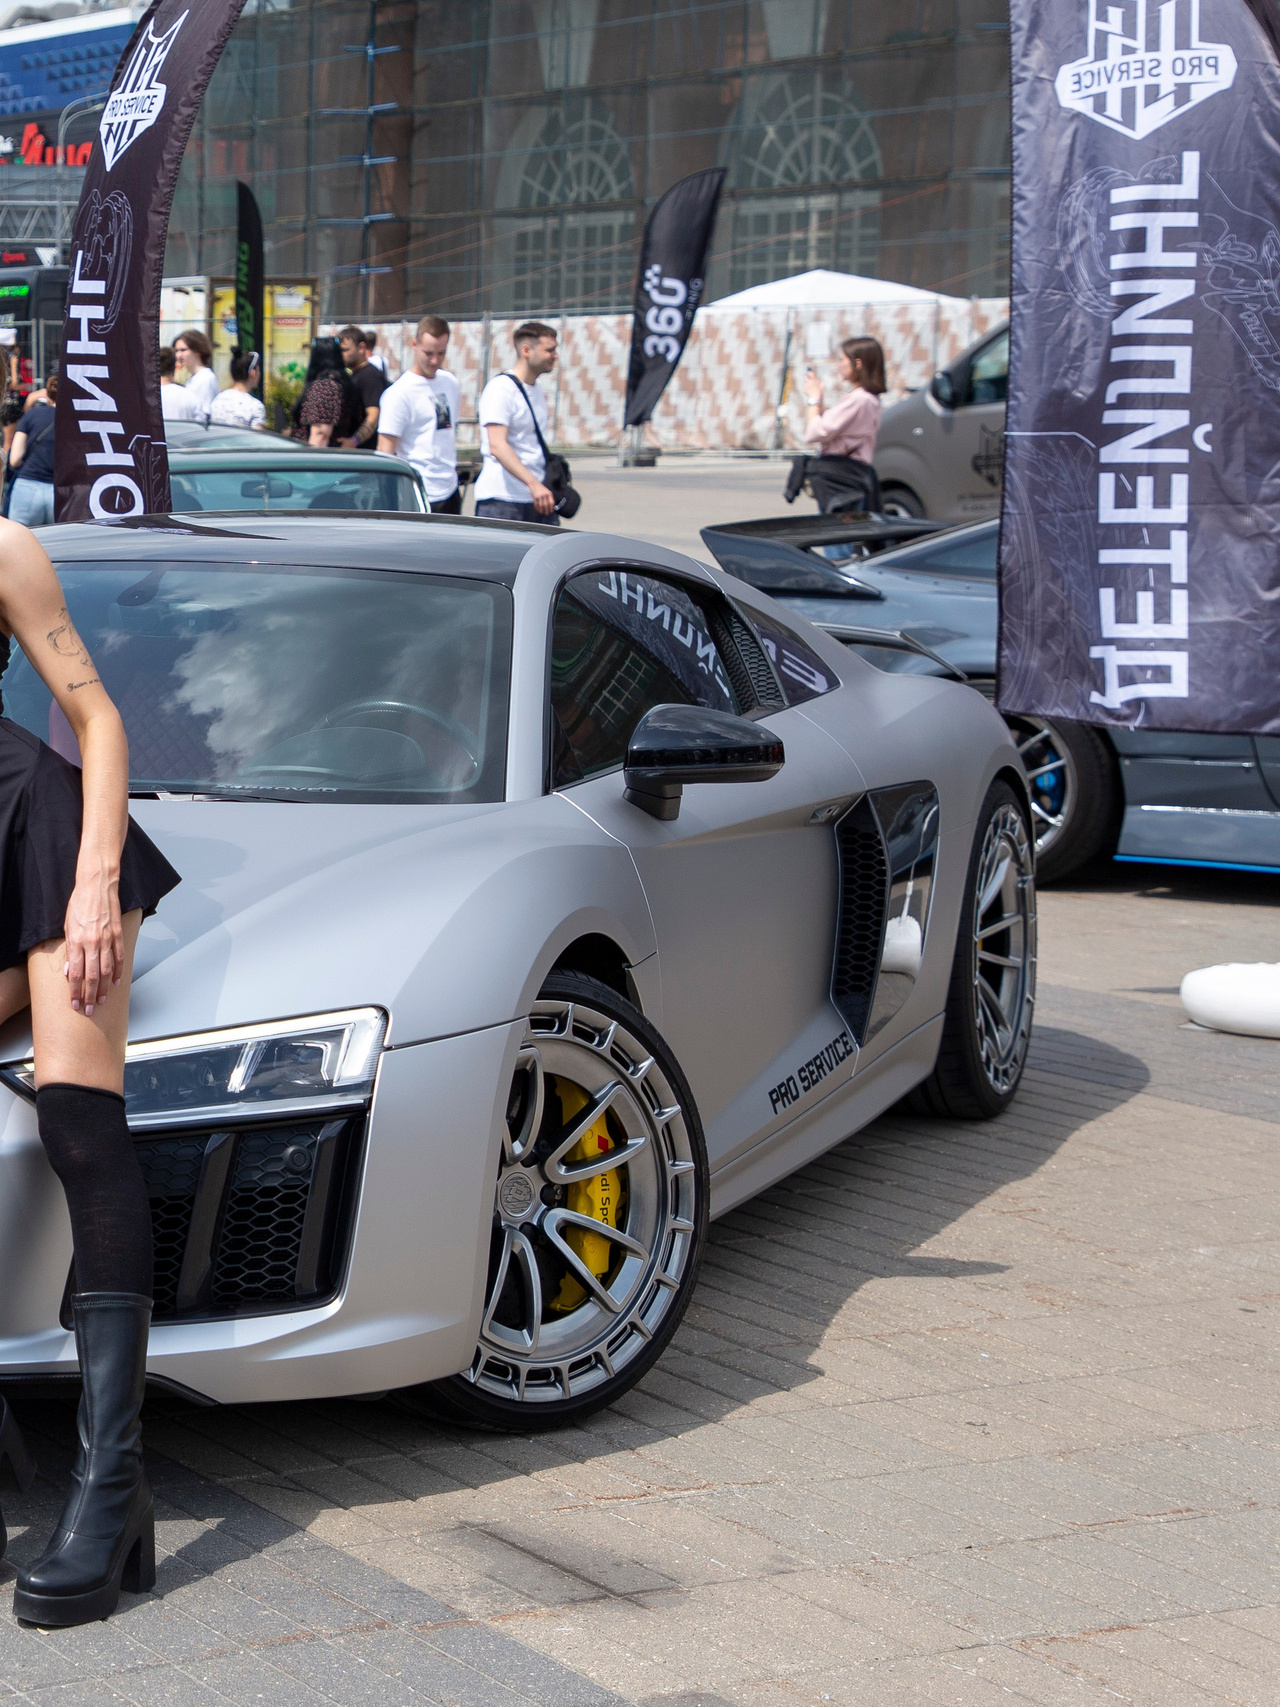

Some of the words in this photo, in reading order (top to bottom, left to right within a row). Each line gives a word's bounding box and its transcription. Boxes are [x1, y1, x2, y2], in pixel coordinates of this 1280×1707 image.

[105, 100, 122, 119] PRO
[120, 94, 158, 118] SERVICE
[768, 1075, 800, 1115] PRO
[797, 1030, 854, 1093] SERVICE
